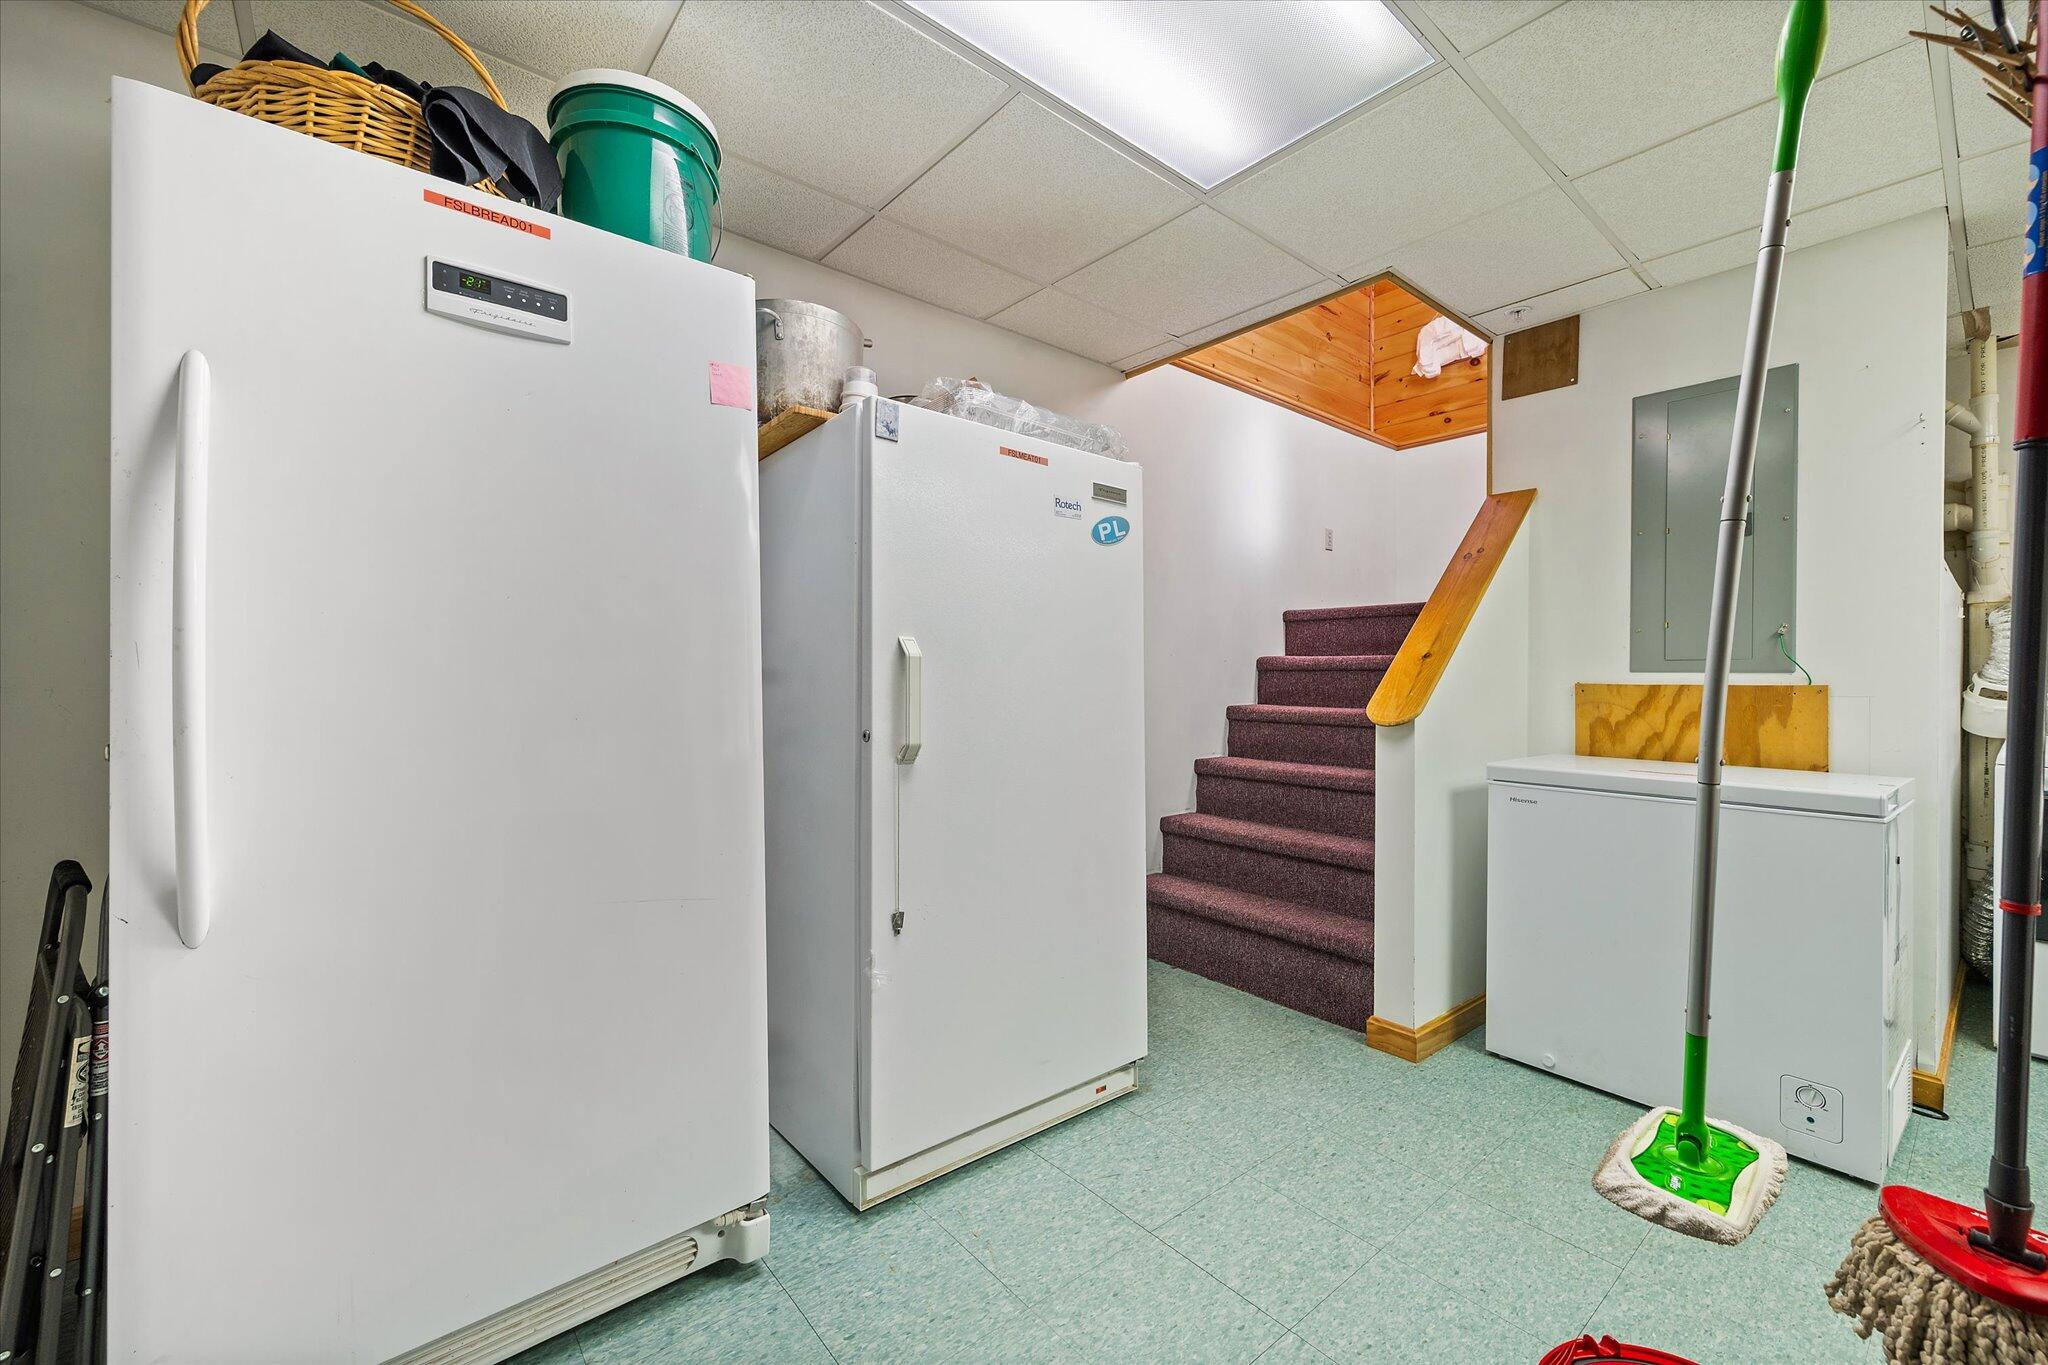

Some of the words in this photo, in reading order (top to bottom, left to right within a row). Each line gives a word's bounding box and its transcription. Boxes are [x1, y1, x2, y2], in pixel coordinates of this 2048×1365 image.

[444, 196, 534, 234] FSLBREAD01
[1007, 448, 1042, 464] FSLMEAT01
[1055, 497, 1082, 512] Rotech
[1097, 519, 1126, 541] PL
[1509, 796, 1538, 805] Hisense
